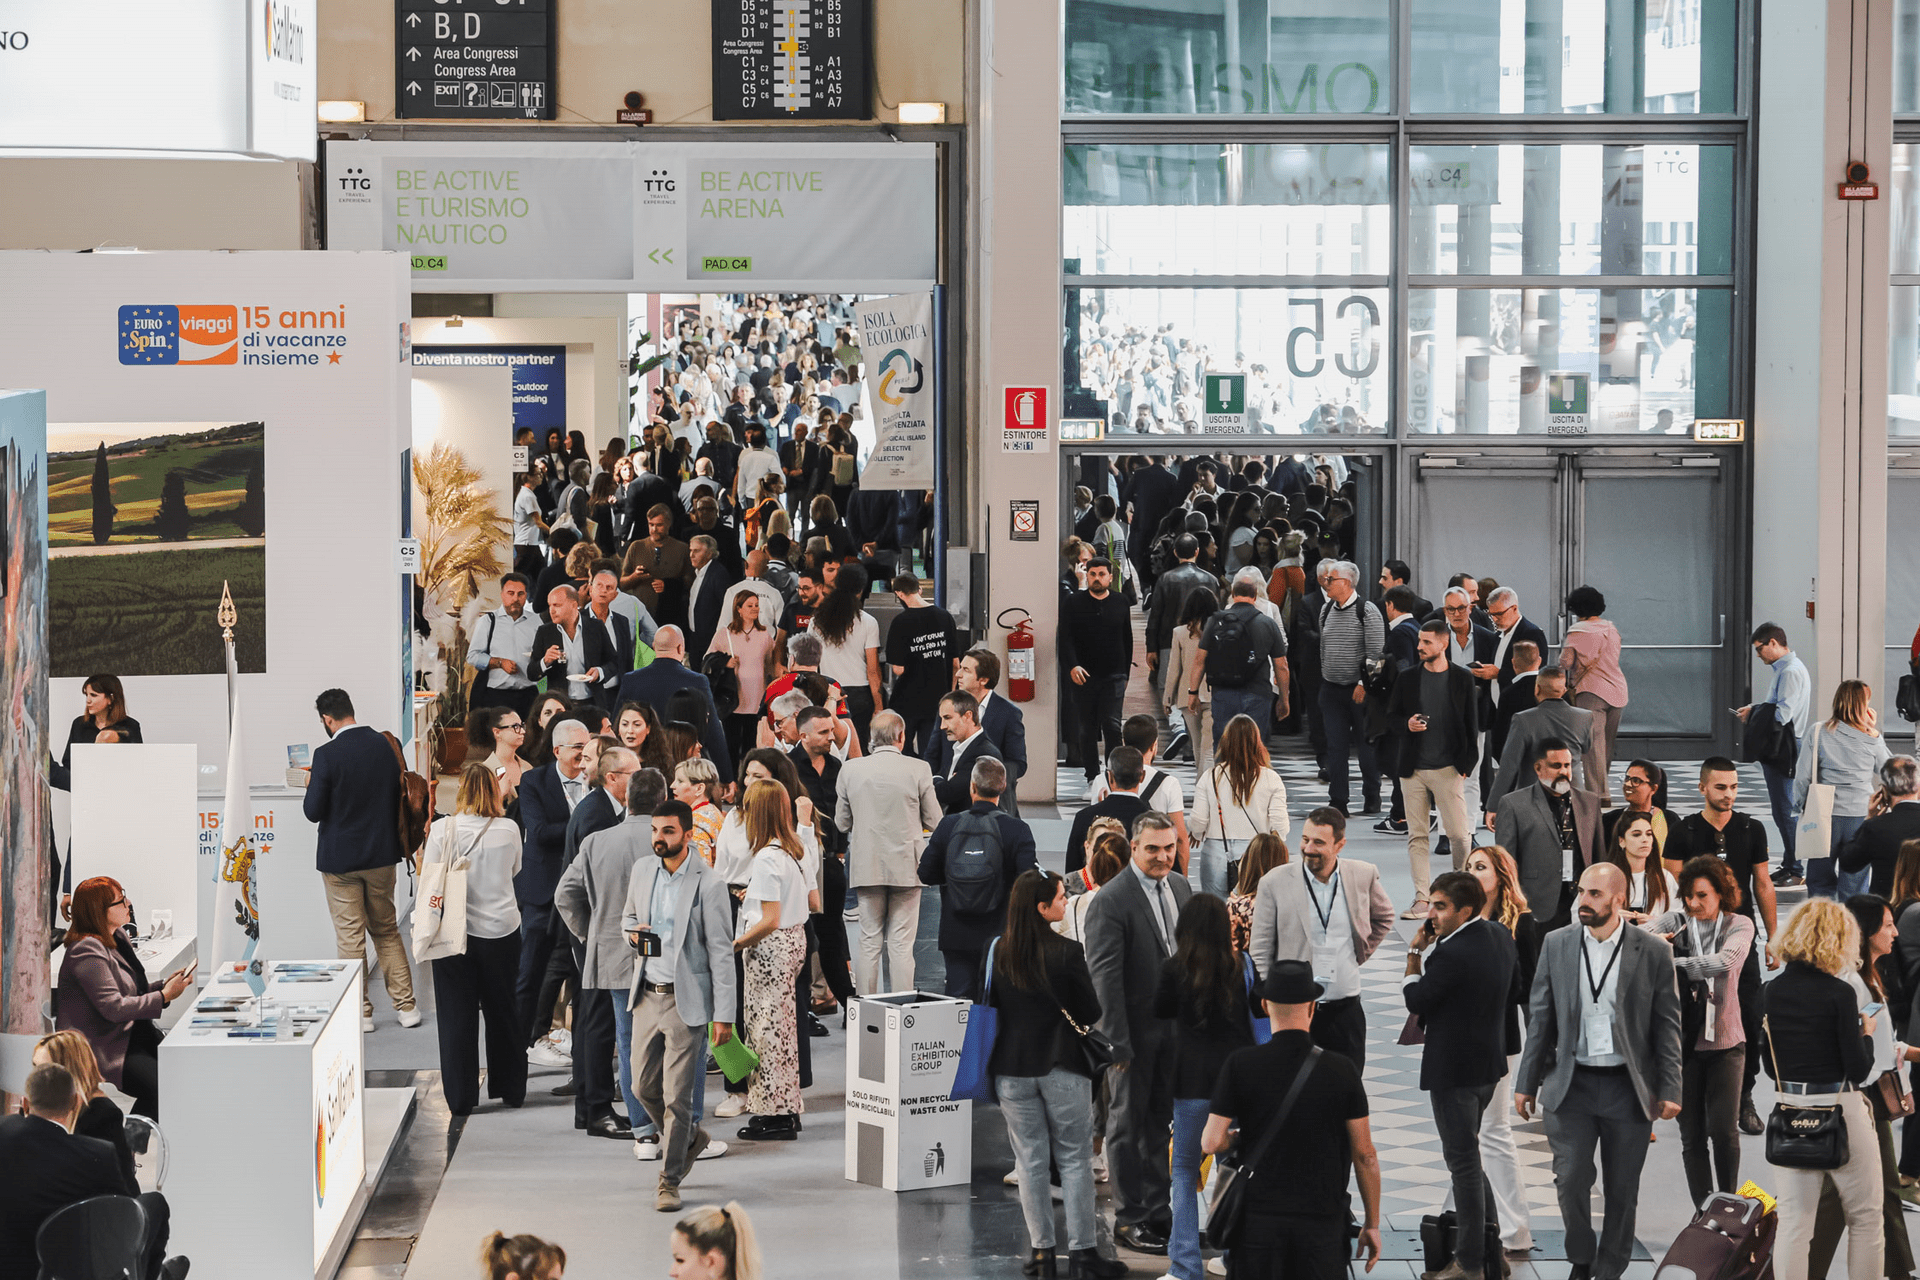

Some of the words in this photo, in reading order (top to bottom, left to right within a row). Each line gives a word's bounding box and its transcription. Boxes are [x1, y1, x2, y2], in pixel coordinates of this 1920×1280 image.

[742, 14, 755, 24] D3
[828, 14, 841, 24] B3
[435, 12, 457, 42] B,
[464, 12, 481, 39] D
[742, 27, 755, 38] D1
[828, 27, 841, 38] B1
[737, 40, 764, 48] Congressi
[434, 47, 460, 59] Area
[463, 47, 519, 62] Congressi
[742, 56, 755, 67] C1
[827, 56, 841, 67] A1
[434, 64, 487, 79] Congress
[490, 64, 516, 76] Area
[742, 70, 756, 80] C3
[828, 70, 841, 80] A3
[436, 85, 460, 95] EXIT
[742, 83, 756, 94] C5
[828, 83, 842, 94] A5
[742, 97, 756, 108] C7
[828, 97, 842, 108] A7
[525, 108, 538, 117] WC
[1654, 162, 1689, 174] TTG
[339, 178, 371, 190] TTG
[397, 170, 427, 190] BE
[433, 170, 520, 191] ACTIVE
[644, 180, 676, 192] TTG
[701, 172, 731, 192] BE
[737, 172, 823, 192] ACTIVE
[397, 197, 410, 217] E
[416, 197, 529, 218] TURISMO
[700, 198, 784, 218] ARENA
[397, 224, 508, 245] NAUTICO
[428, 258, 444, 268] C4
[705, 260, 730, 270] PAD.
[732, 260, 748, 269] C4
[242, 306, 270, 328] 15
[279, 304, 345, 328] anni
[864, 311, 896, 330] ISOLA
[134, 318, 163, 330] EURO
[130, 330, 167, 352] Spin
[243, 332, 260, 347] di
[265, 334, 347, 347] vacanze
[866, 324, 927, 347] ECOLOGICA
[243, 350, 319, 365] insieme
[413, 353, 462, 365] Diventa
[464, 355, 505, 365] nostro
[508, 354, 555, 366] partner
[1209, 415, 1230, 424] USCITA
[1232, 415, 1240, 423] DI
[1004, 431, 1047, 439] ESTINTORE
[1205, 426, 1245, 434] EMERGENZA
[1548, 426, 1588, 434] EMERGENZA
[401, 547, 415, 555] C5
[199, 812, 219, 829] 15
[199, 830, 212, 841] di
[911, 1041, 945, 1051] ITALIAN
[911, 1049, 962, 1062] EXHIBITION
[911, 1061, 942, 1071] GROUP
[852, 1090, 868, 1100] SOLO
[869, 1094, 890, 1105] RIFIUTI
[901, 1097, 917, 1105] NON
[919, 1096, 950, 1104] RECYCL
[847, 1100, 860, 1109] NON
[861, 1103, 895, 1117] RICICLABILI
[910, 1106, 937, 1116] WASTE
[939, 1104, 960, 1114] ONLY
